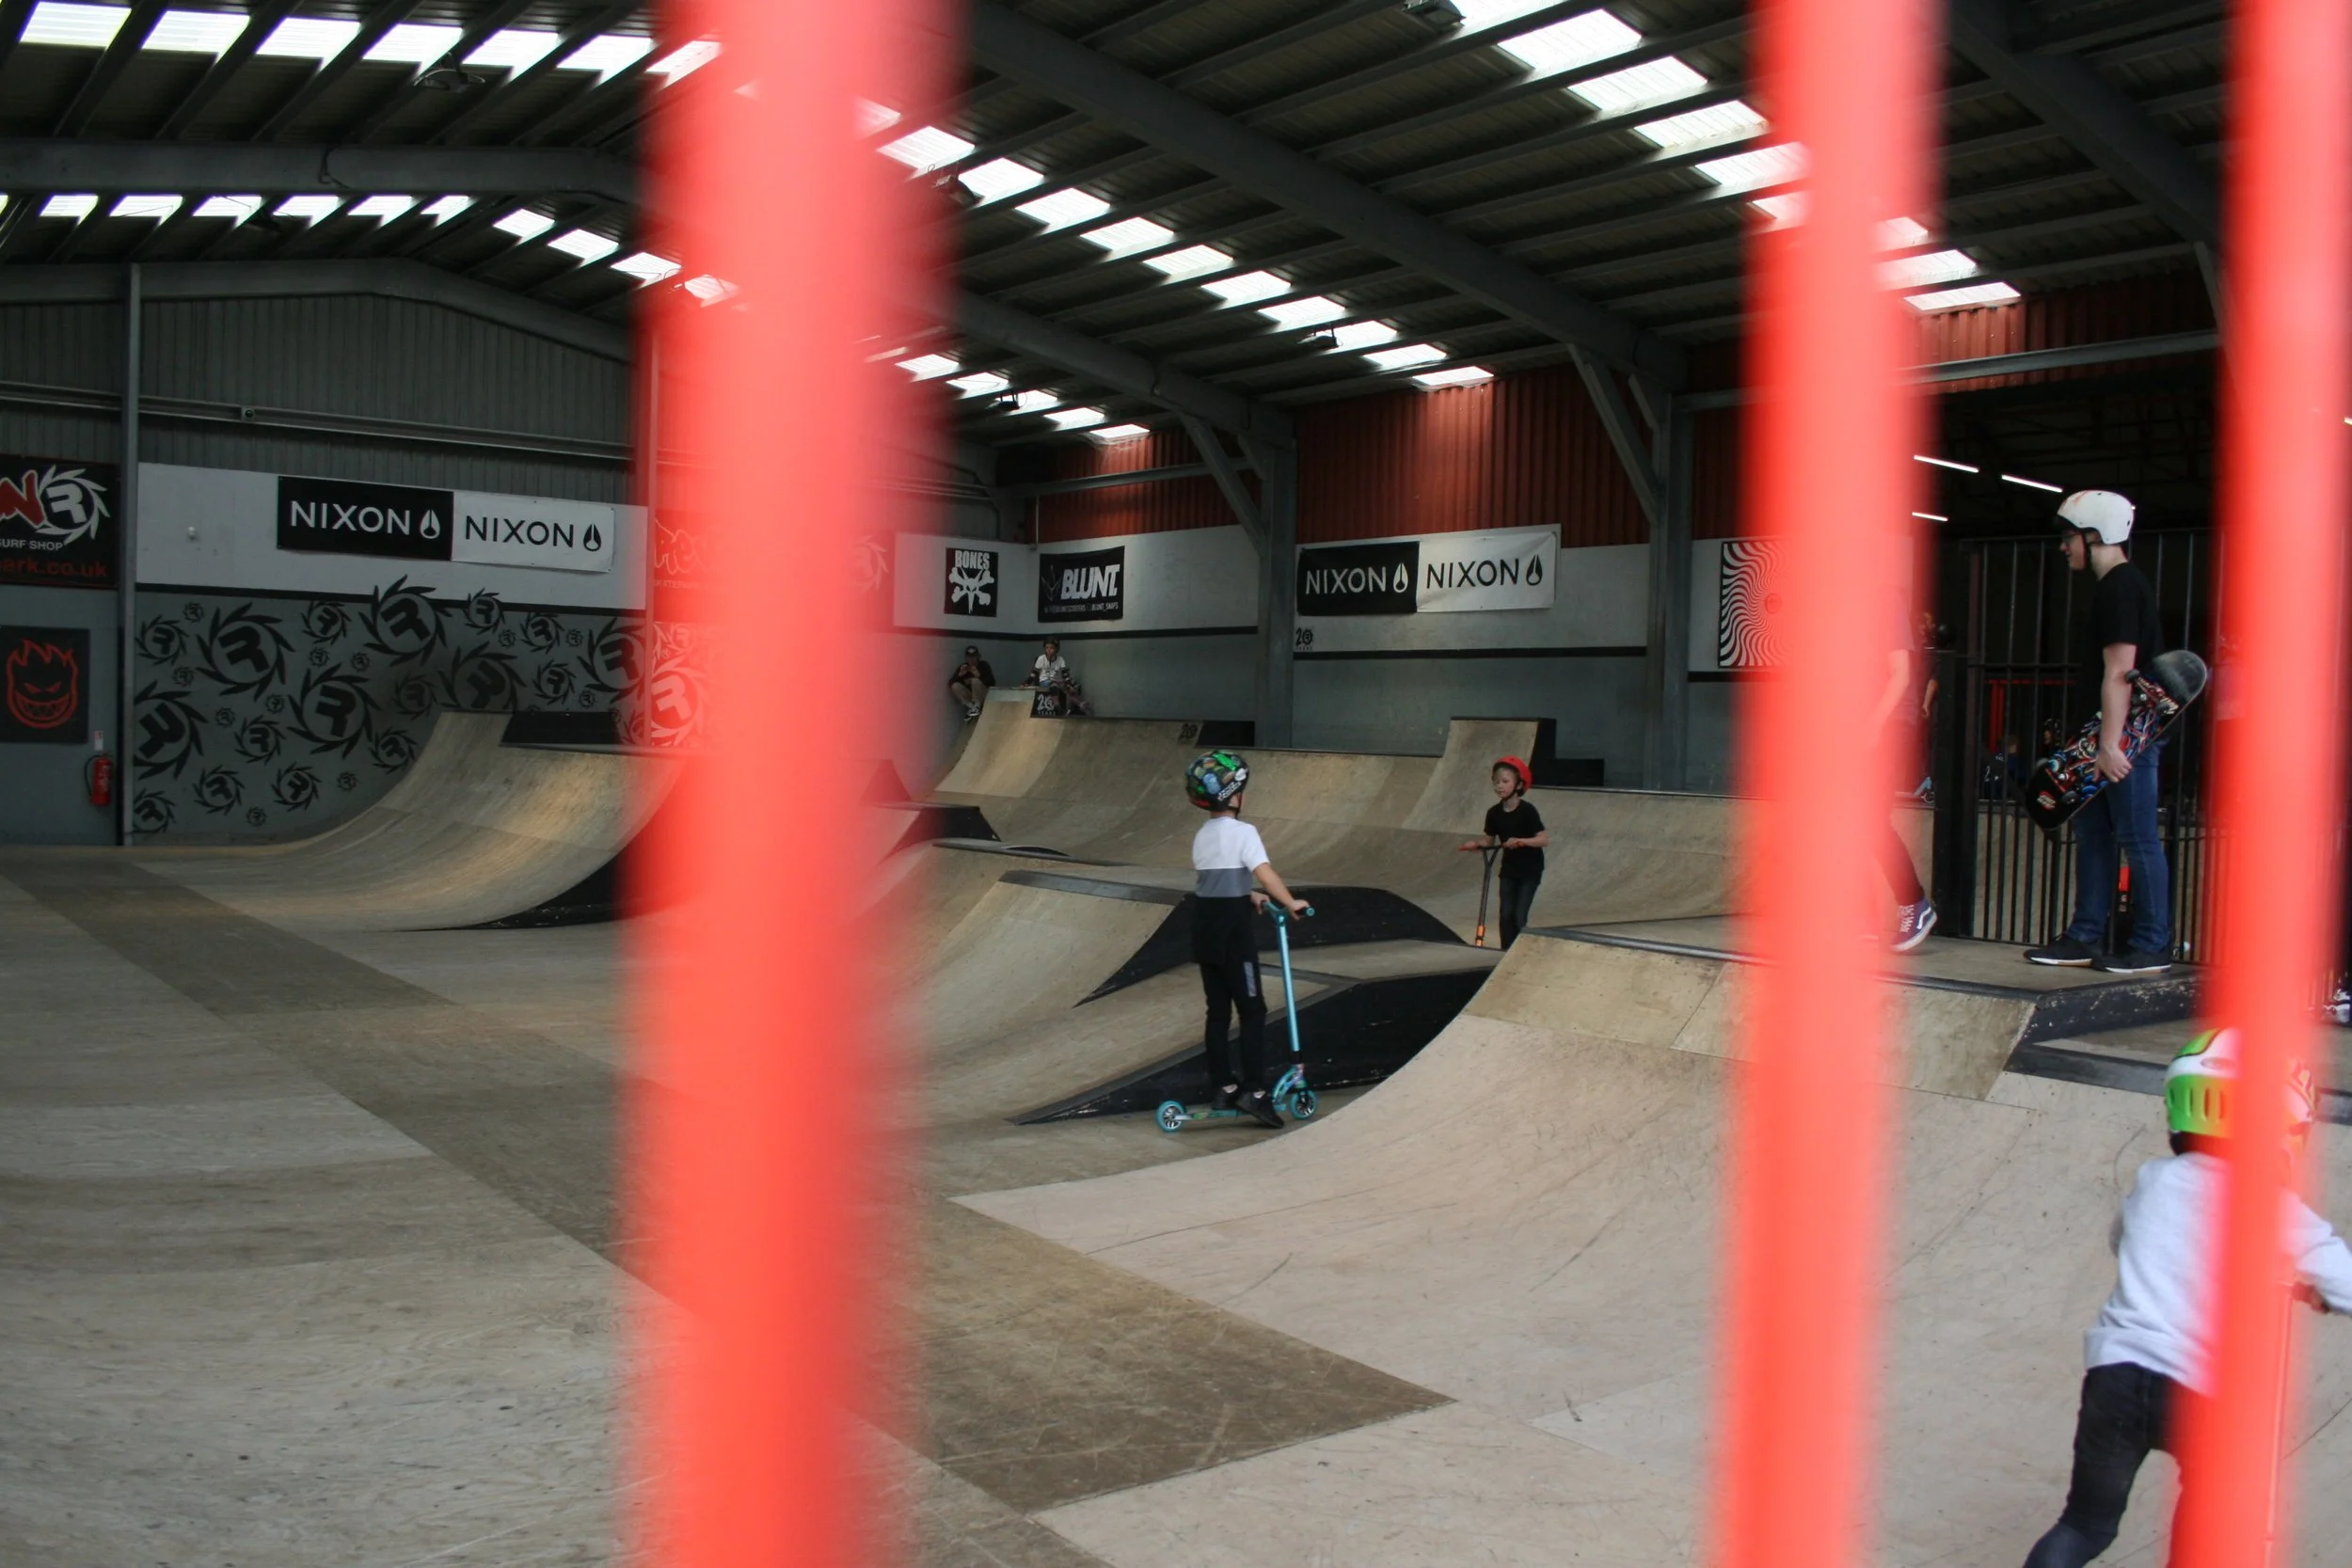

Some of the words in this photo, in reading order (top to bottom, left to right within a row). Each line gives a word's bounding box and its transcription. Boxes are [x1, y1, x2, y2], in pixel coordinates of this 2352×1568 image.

[290, 500, 410, 536] NIXON
[465, 515, 574, 548] NIXON
[29, 540, 64, 551] SHOP
[955, 549, 990, 570] BONES
[1305, 566, 1386, 594] NIXON
[1426, 558, 1518, 590] NIXON
